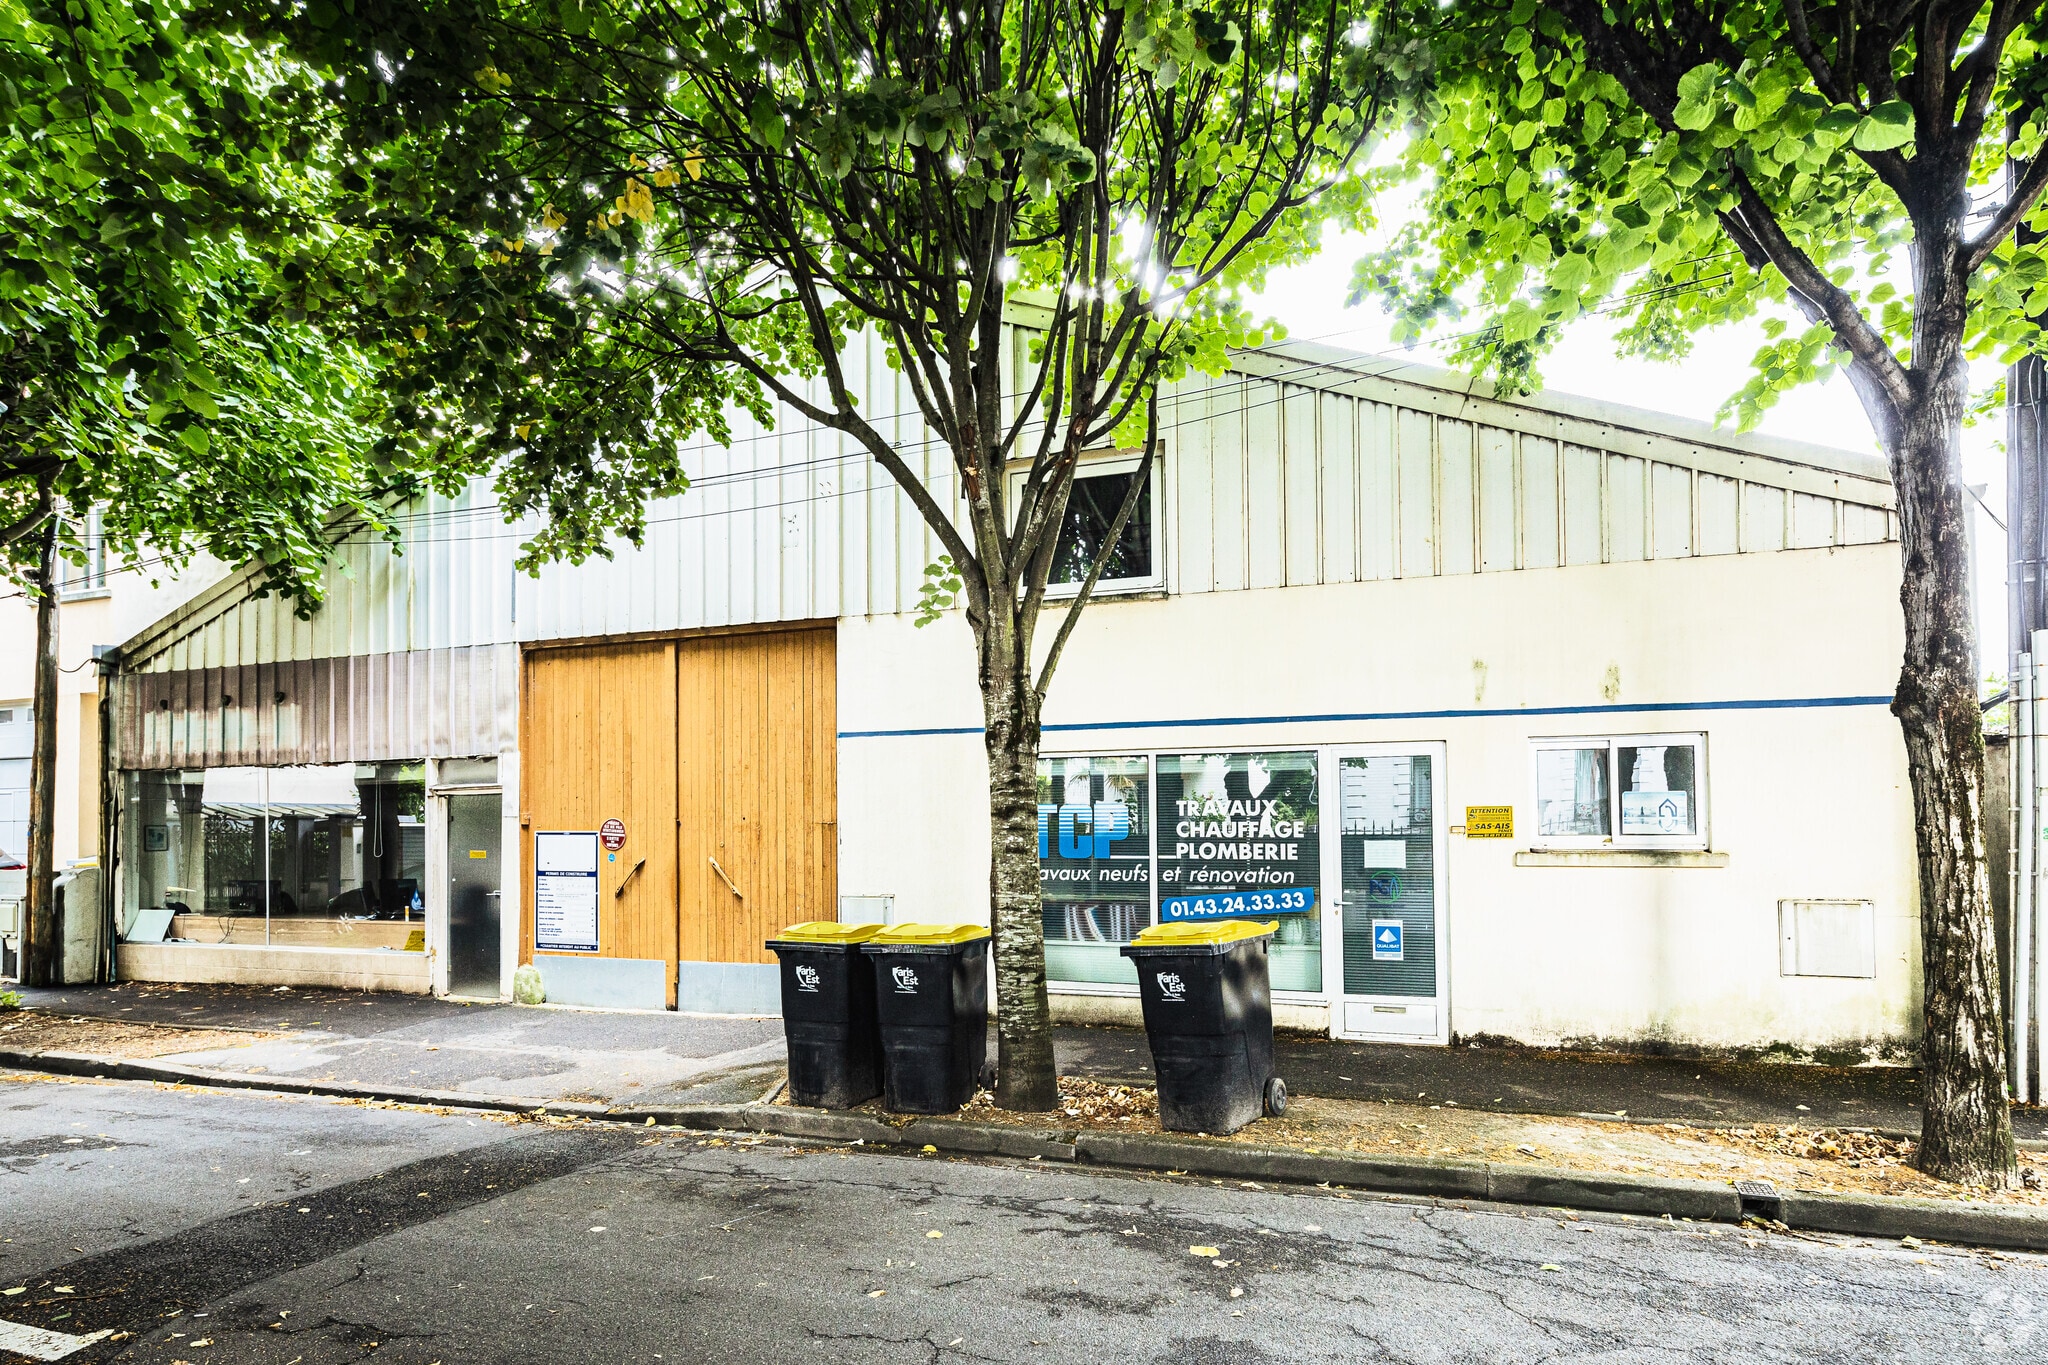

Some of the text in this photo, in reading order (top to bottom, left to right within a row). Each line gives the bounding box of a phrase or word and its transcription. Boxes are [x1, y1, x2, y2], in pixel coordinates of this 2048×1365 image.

[1176, 800, 1278, 816] TRAVAUX
[1176, 821, 1304, 838] CHAUFFAGE
[1176, 843, 1298, 860] PLOMBERIE
[1039, 864, 1295, 883] avaux neufs et rénovation
[1170, 892, 1305, 917] 01.43.24.33.33
[795, 965, 816, 976] Paris
[892, 966, 914, 977] Paris
[805, 975, 820, 984] Est
[903, 976, 919, 986] Est
[1156, 972, 1180, 983] Paris
[1169, 982, 1186, 992] Est
